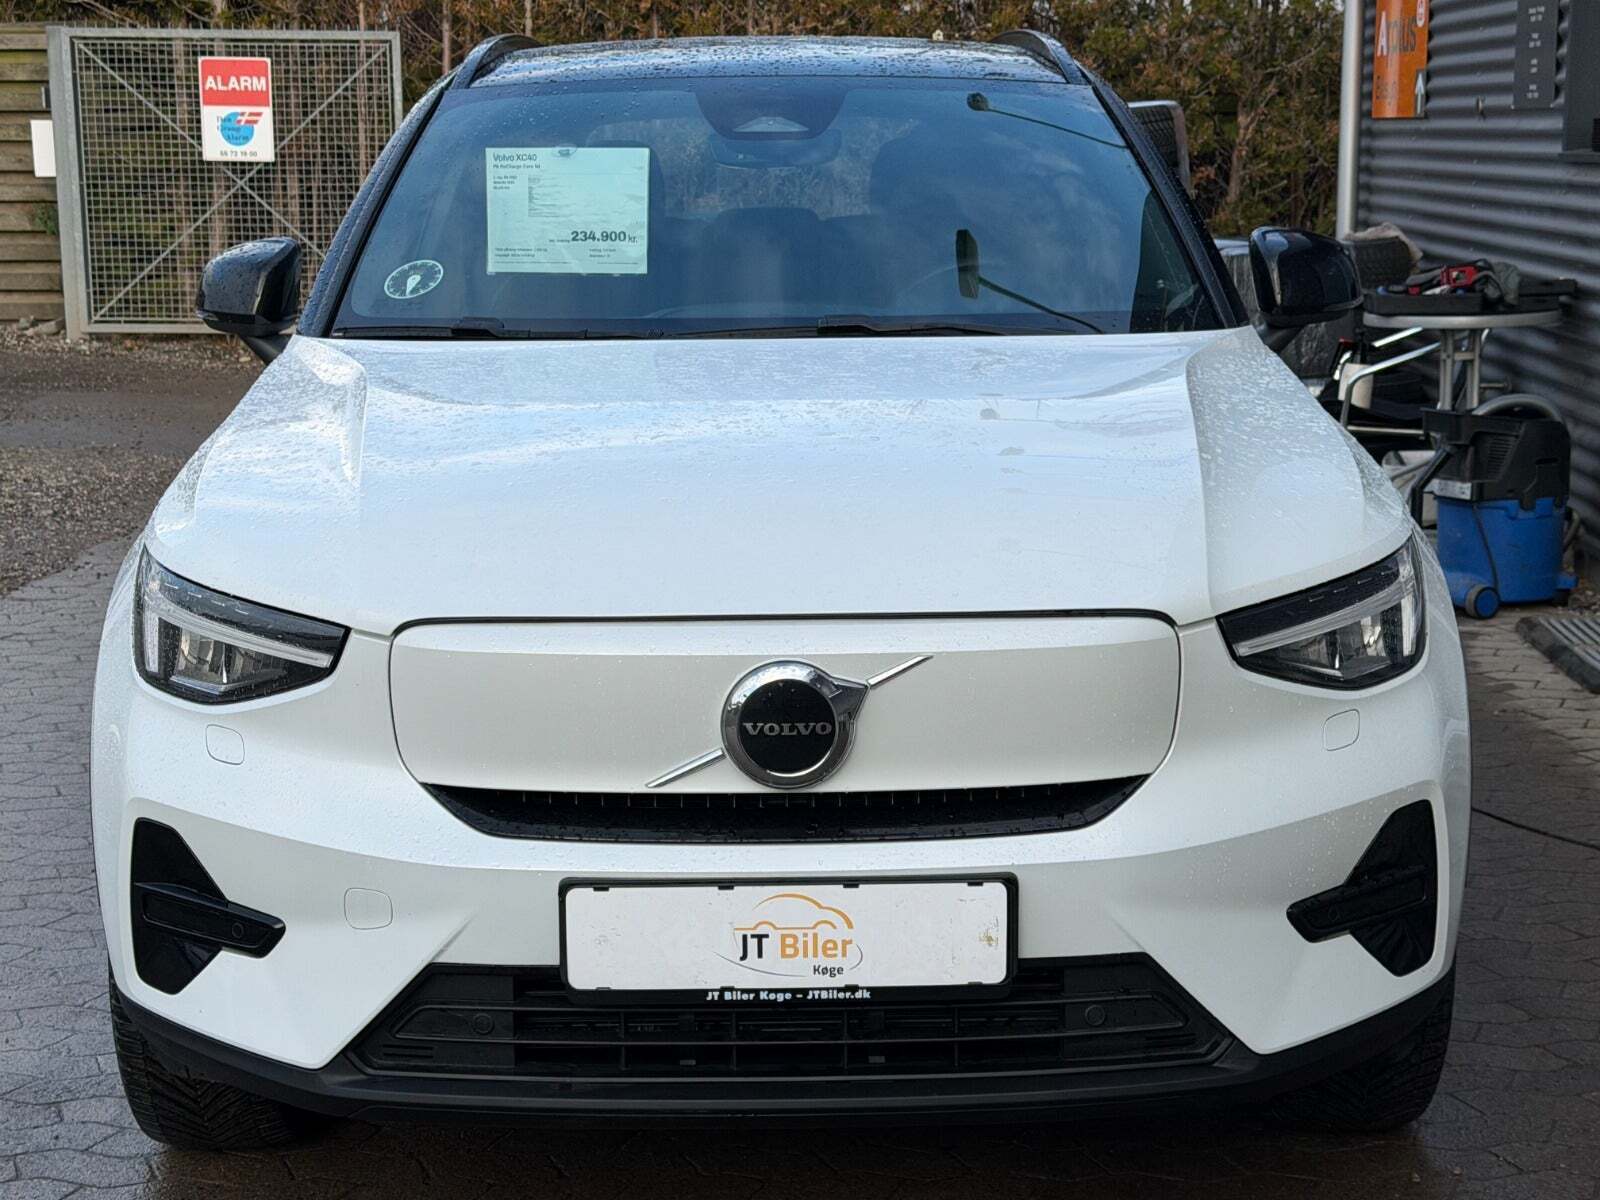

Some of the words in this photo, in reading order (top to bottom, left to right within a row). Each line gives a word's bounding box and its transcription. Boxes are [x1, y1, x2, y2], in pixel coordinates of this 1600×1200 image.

[205, 75, 267, 91] ALARM
[493, 152, 515, 162] Volvo
[516, 152, 537, 162] XC40
[571, 230, 627, 242] 234.900
[628, 234, 638, 244] kr.
[743, 722, 832, 736] VOLVO
[739, 933, 769, 961] JT
[780, 932, 853, 960] Biler
[813, 964, 844, 978] Køge
[706, 991, 720, 1001] JT
[724, 991, 755, 1001] Biler
[807, 989, 871, 1000] JTBiler.dk
